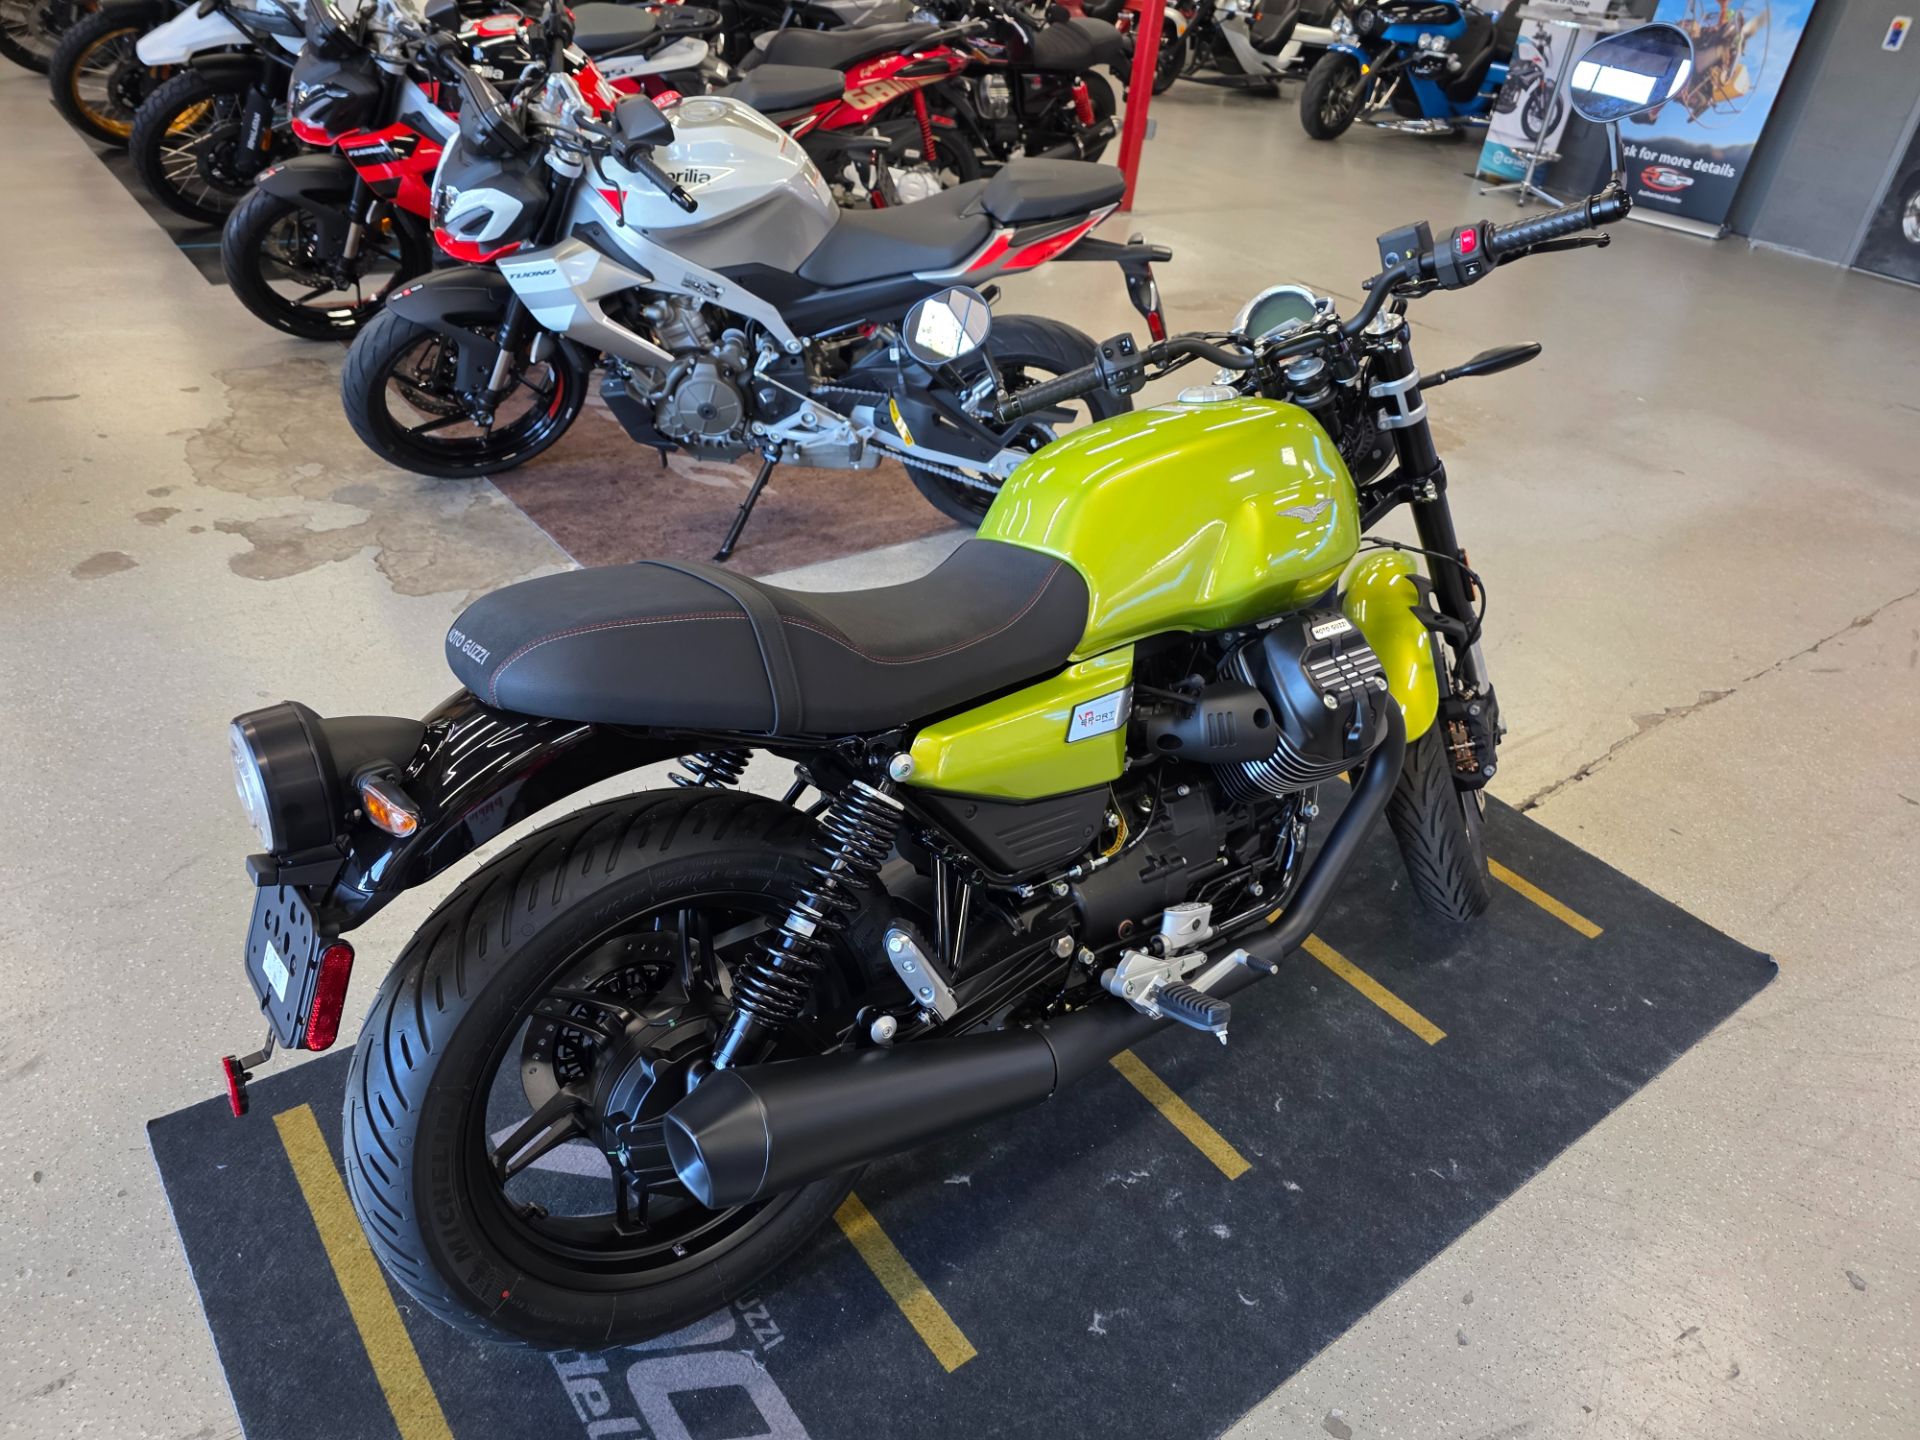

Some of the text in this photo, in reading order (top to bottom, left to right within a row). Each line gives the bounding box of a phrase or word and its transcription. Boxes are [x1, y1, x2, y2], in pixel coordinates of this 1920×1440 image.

[1622, 144, 1639, 158] sk
[1639, 145, 1659, 162] for
[1658, 152, 1692, 169] more
[1693, 158, 1737, 179] details
[669, 168, 712, 185] rilia
[508, 268, 558, 280] TUONO
[1314, 620, 1347, 634] MOTO GUZZI
[462, 639, 491, 666] GUZZI
[1080, 710, 1115, 727] SPORT
[733, 1295, 787, 1351] UZZI
